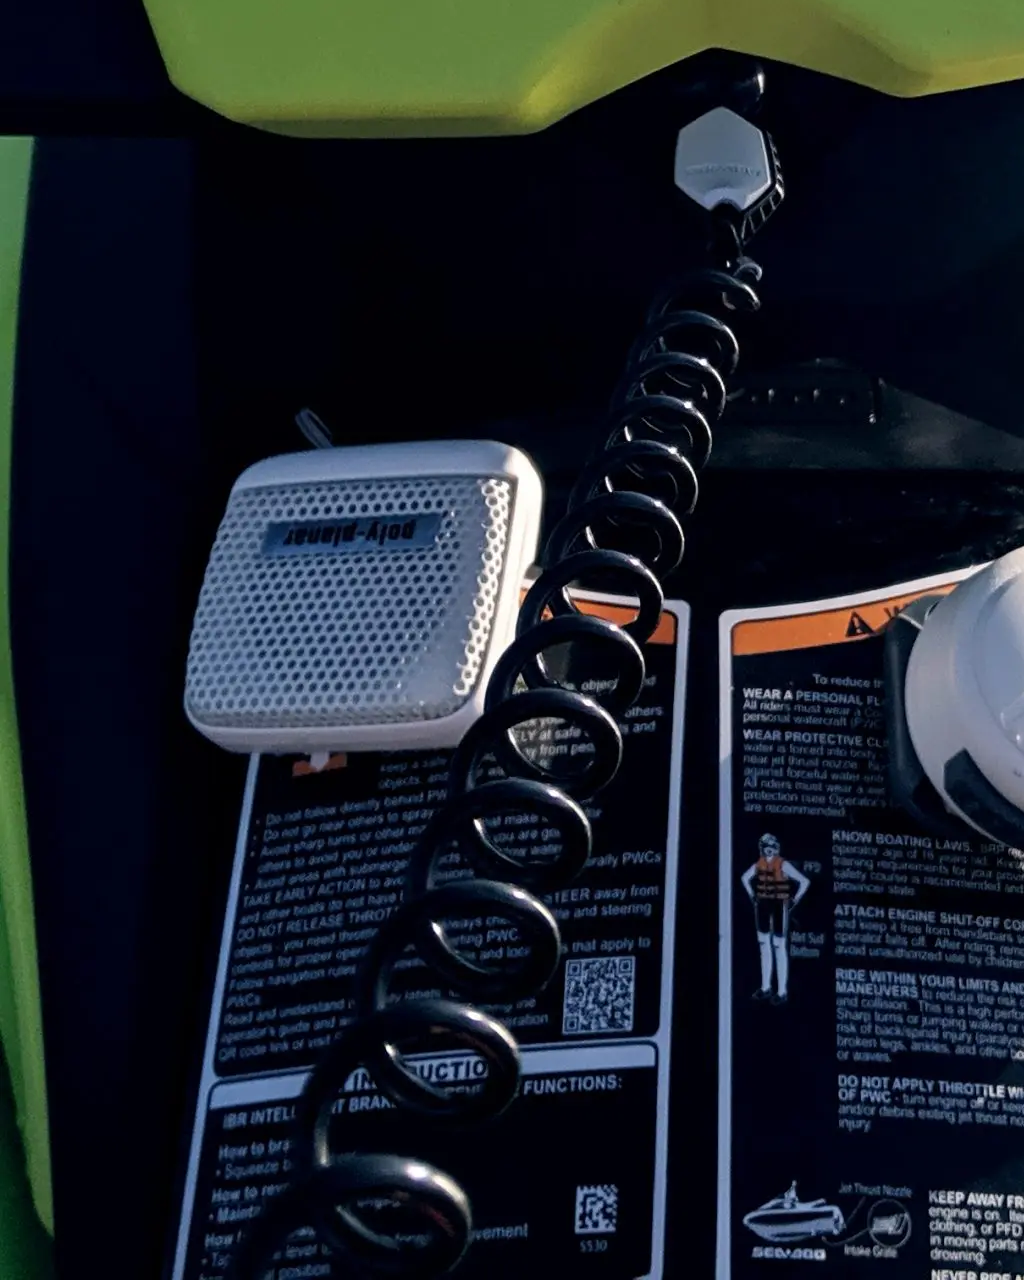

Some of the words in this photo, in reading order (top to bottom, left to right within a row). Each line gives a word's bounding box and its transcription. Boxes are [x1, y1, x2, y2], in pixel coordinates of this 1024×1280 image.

[283, 519, 416, 546] poly-planar
[812, 673, 827, 685] To
[830, 676, 870, 688] reduce
[742, 688, 782, 700] WEAR
[783, 689, 793, 700] A
[796, 691, 863, 706] PERSONAL
[743, 699, 757, 710] All
[759, 701, 791, 711] riders
[624, 706, 664, 718] others
[555, 726, 581, 739] safe
[632, 721, 656, 732] and
[742, 729, 782, 742] WEAR
[785, 731, 863, 748] PROTECTIVE
[539, 743, 567, 755] from
[832, 830, 872, 844] KNOW
[876, 832, 932, 849] BOATING
[935, 838, 973, 852] LAWS.
[622, 850, 661, 863] PWCs
[317, 879, 366, 896] ACTION
[594, 888, 627, 901] away
[630, 885, 659, 897] from
[573, 907, 597, 918] and
[601, 903, 652, 917] steering
[834, 904, 885, 918] ATTACH
[888, 907, 936, 923] ENGINE
[940, 912, 1000, 929] SHUT-OFF
[237, 927, 255, 942] DO
[258, 922, 283, 937] NOT
[286, 913, 344, 932] RELEASE
[600, 938, 633, 952] apply
[638, 936, 651, 948] to
[835, 967, 866, 982] RIDE
[869, 970, 916, 985] WITHIN
[919, 974, 956, 988] YOUR
[958, 977, 999, 992] LIMITS
[835, 981, 918, 998] MANEUVERS
[838, 1073, 858, 1088] DO
[861, 1075, 890, 1089] NOT
[892, 1077, 935, 1093] APPLY
[938, 1080, 1006, 1099] THROTTLE
[223, 1111, 248, 1130] IBR
[523, 1073, 623, 1096] FUNCTIONS:
[838, 1087, 856, 1101] OF
[860, 1090, 891, 1103] PWC
[928, 1190, 965, 1205] KEEP
[967, 1193, 1004, 1208] AWAY
[928, 1207, 969, 1221] engine
[971, 1207, 982, 1219] is
[980, 1224, 994, 1235] or
[996, 1224, 1023, 1238] PFD
[929, 1235, 942, 1247] in
[944, 1236, 987, 1253] moving
[989, 1239, 1018, 1253] parts
[931, 1269, 978, 1280] NEVER
